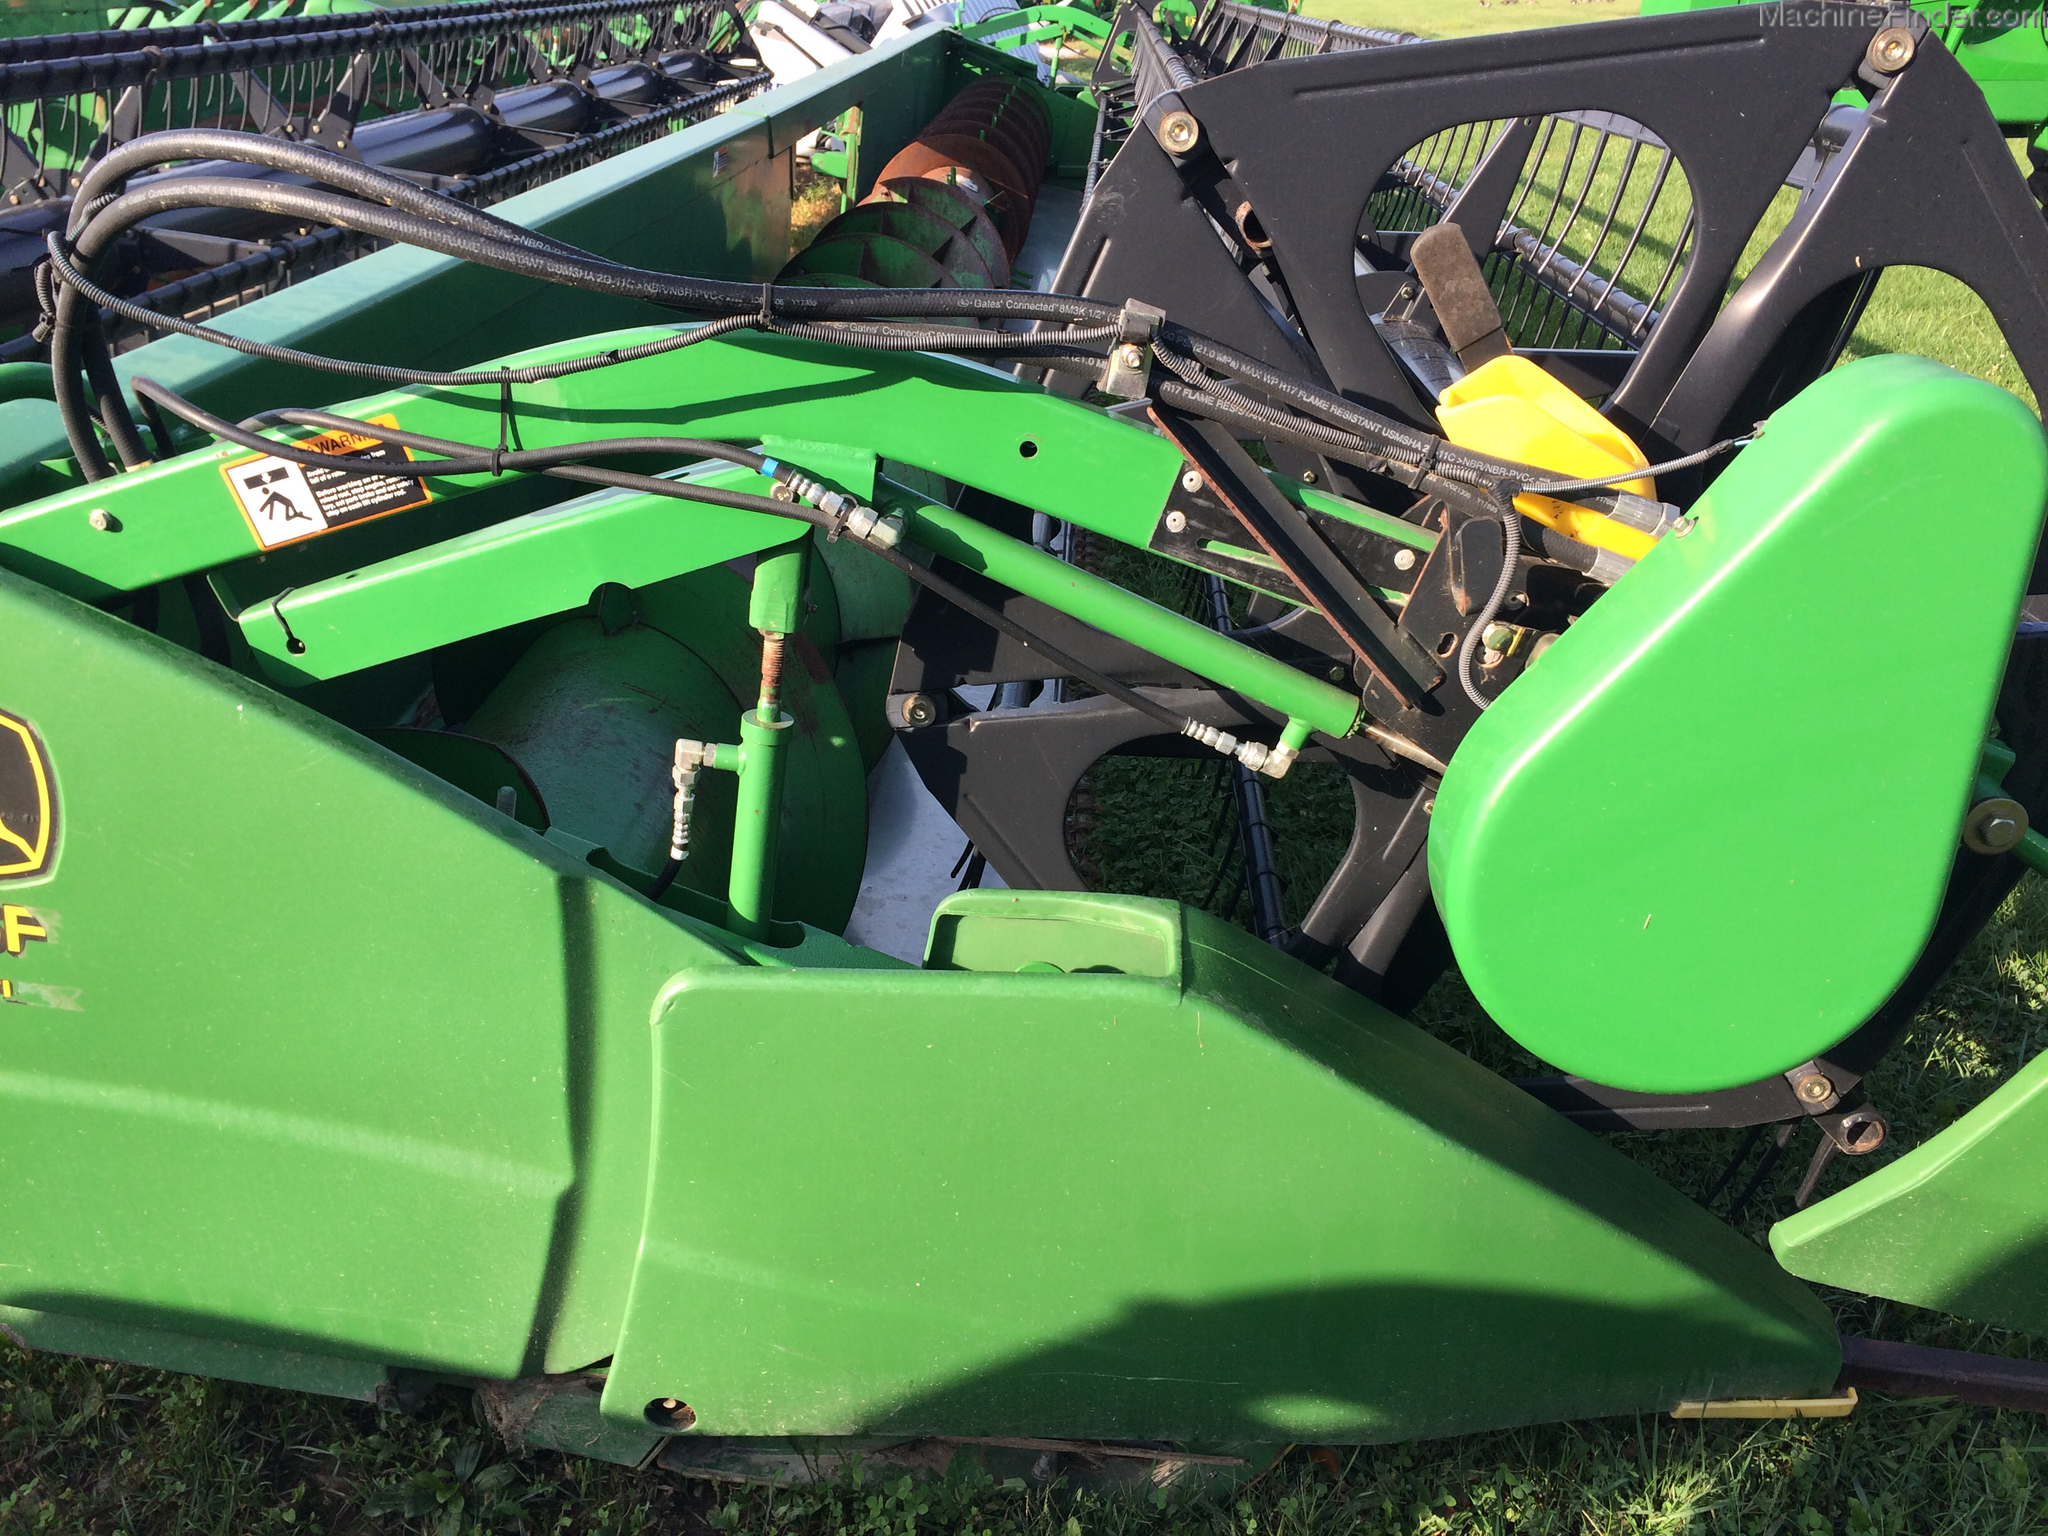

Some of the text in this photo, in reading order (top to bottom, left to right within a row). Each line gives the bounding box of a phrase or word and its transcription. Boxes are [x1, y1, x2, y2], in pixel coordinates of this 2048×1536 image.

[1059, 305, 1086, 316] 8M3K
[1163, 382, 1182, 394] R17
[1182, 389, 1215, 406] FLAME
[1193, 343, 1215, 358] (21.0
[1216, 352, 1239, 370] MPa)
[1240, 364, 1262, 380] MAX
[1263, 373, 1279, 387] WP
[1278, 382, 1298, 395] R17
[1297, 390, 1330, 411] FLAME
[1329, 404, 1382, 433] RESISTANT
[1382, 425, 1421, 450] USMSHA
[1421, 443, 1455, 463] 2-11C
[315, 487, 336, 498] Before
[336, 480, 362, 492] working
